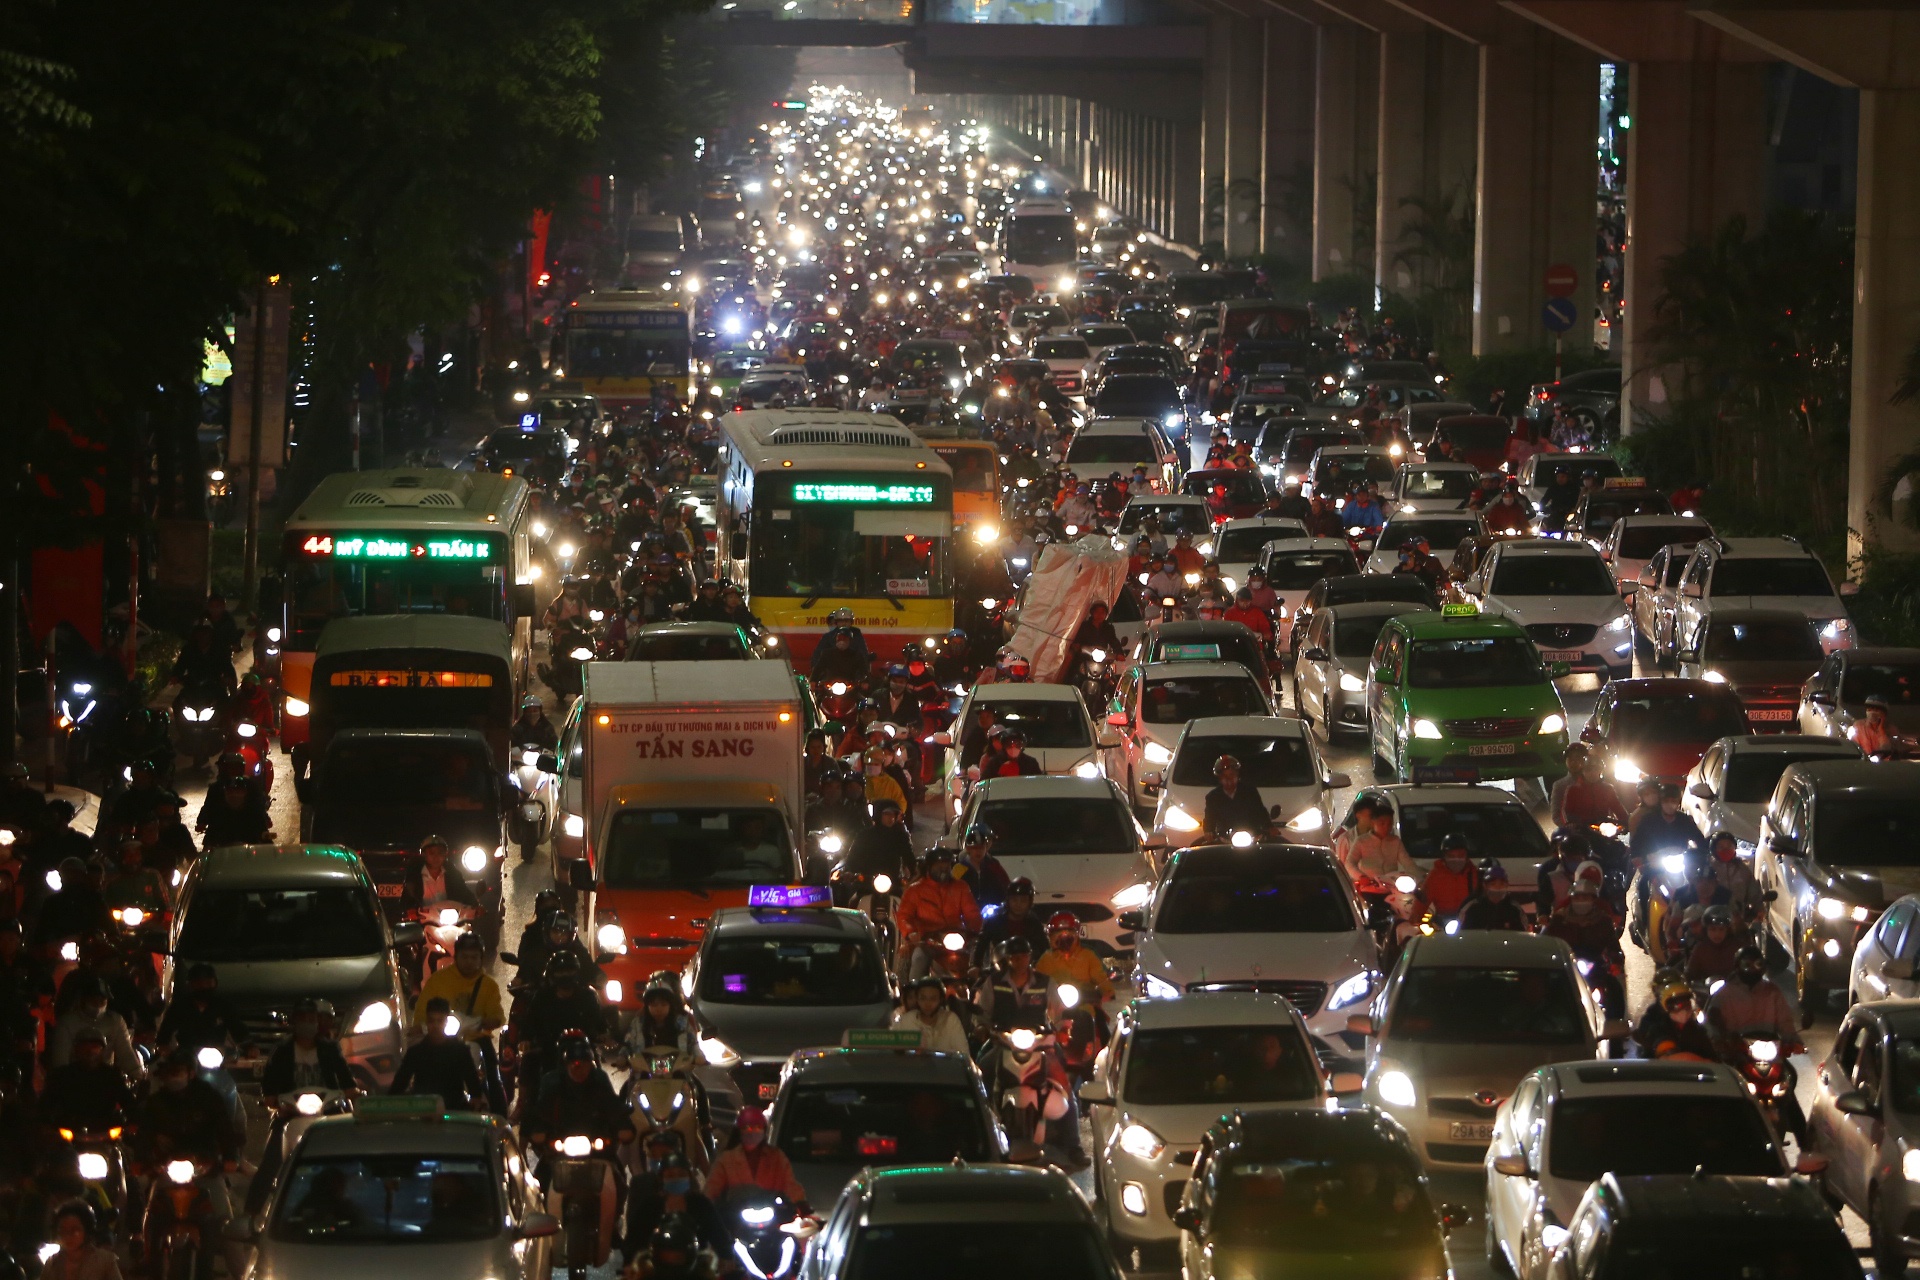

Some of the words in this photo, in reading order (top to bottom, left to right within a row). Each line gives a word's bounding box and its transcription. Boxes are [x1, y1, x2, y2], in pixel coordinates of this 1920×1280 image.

[304, 536, 332, 553] 44
[476, 542, 489, 558] K
[632, 723, 643, 732] CP
[734, 722, 741, 731] &
[691, 738, 755, 758] SANG
